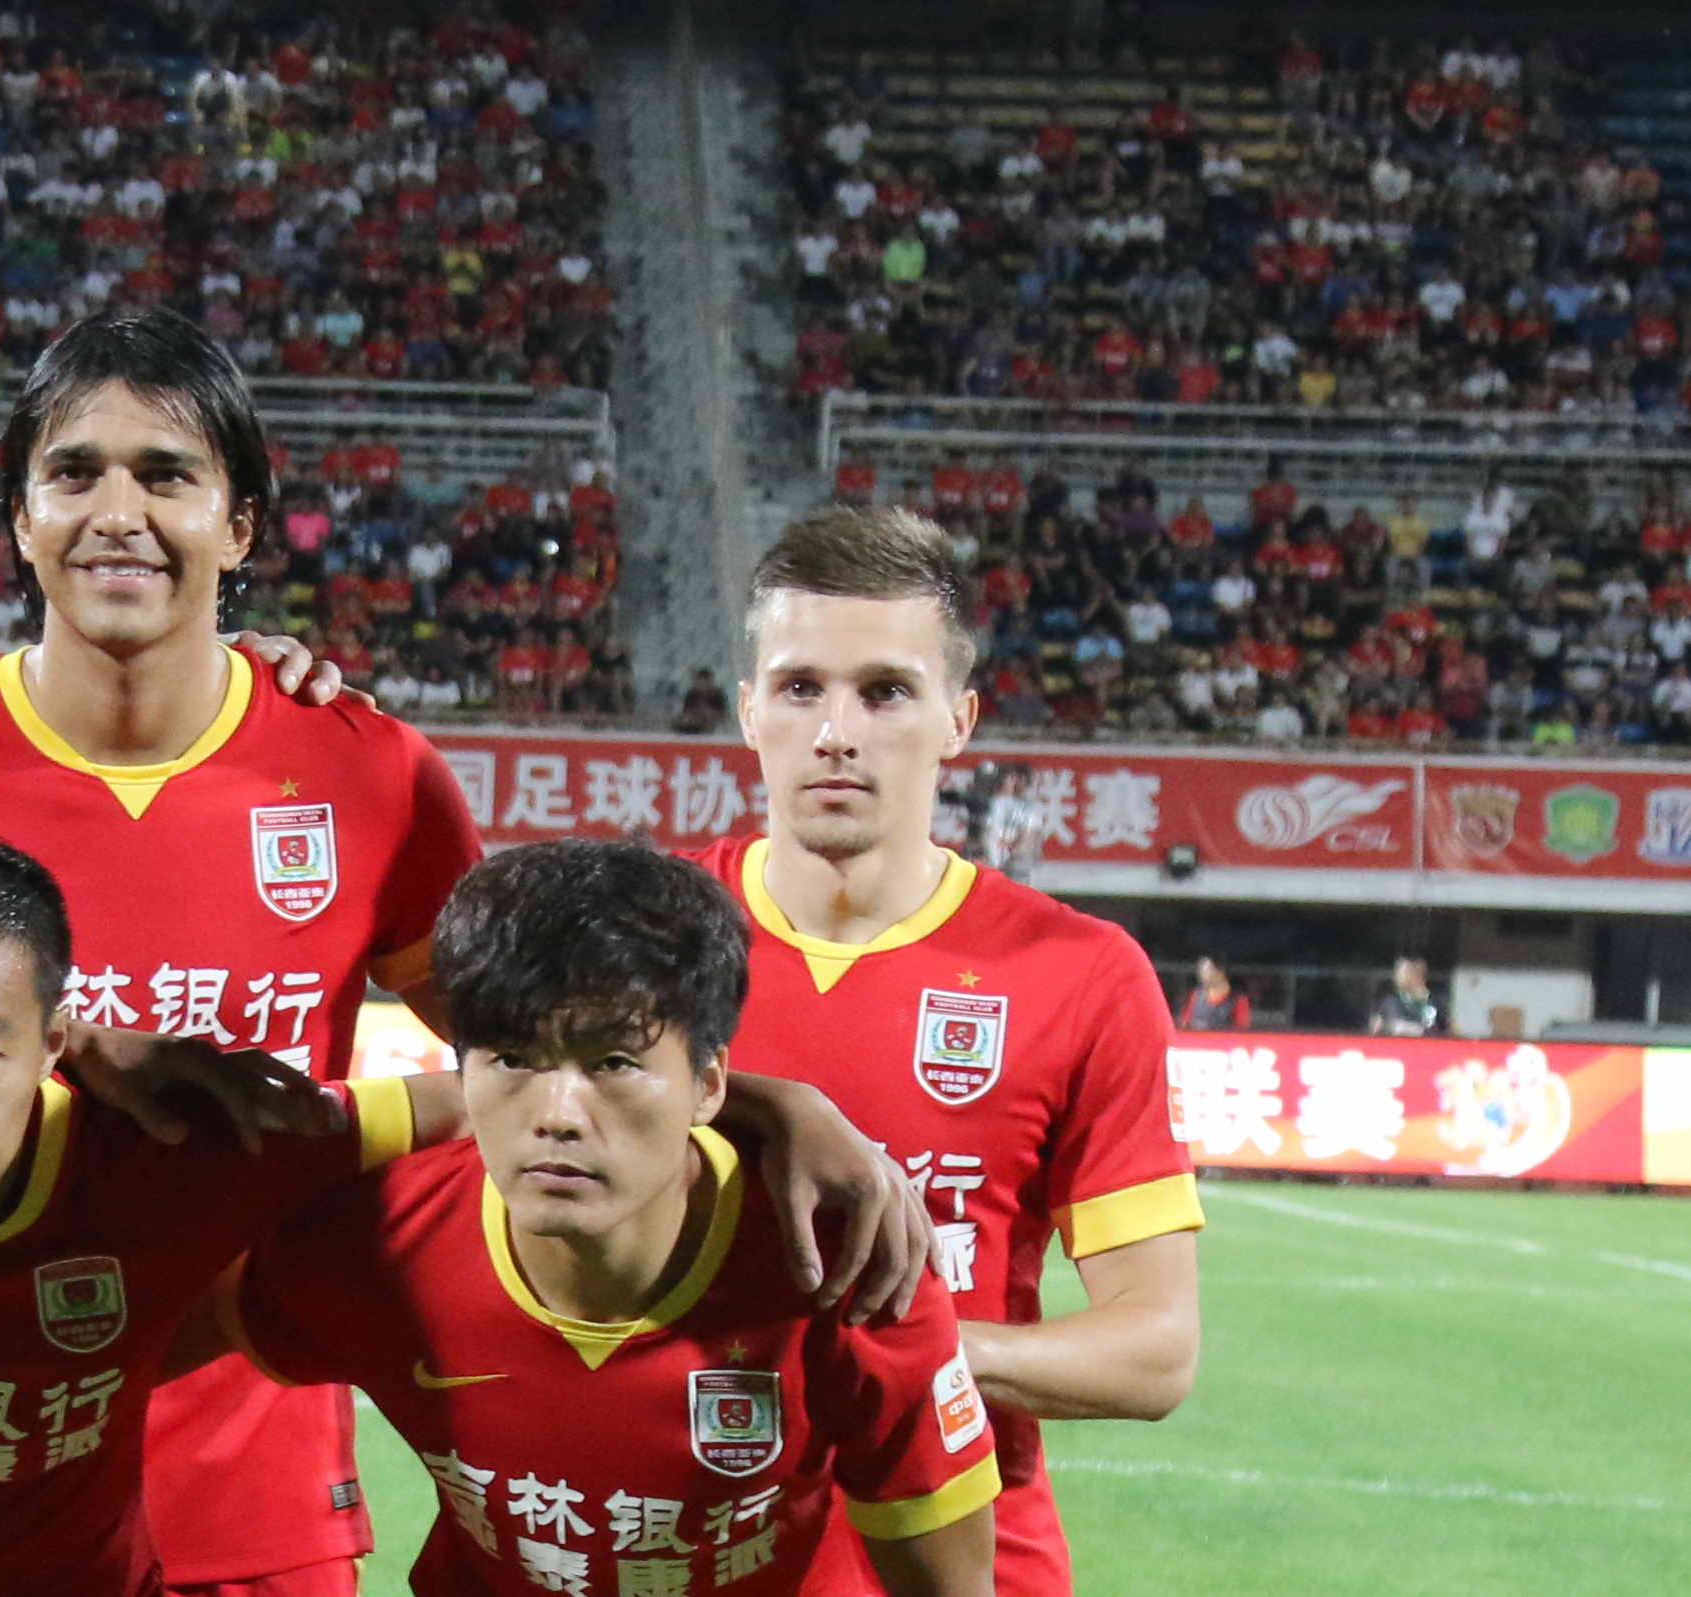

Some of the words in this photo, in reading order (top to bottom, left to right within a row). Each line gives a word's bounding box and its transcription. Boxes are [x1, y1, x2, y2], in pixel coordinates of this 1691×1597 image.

[445, 749, 769, 834] 国足球协
[422, 1448, 784, 1556] 吉林银行
